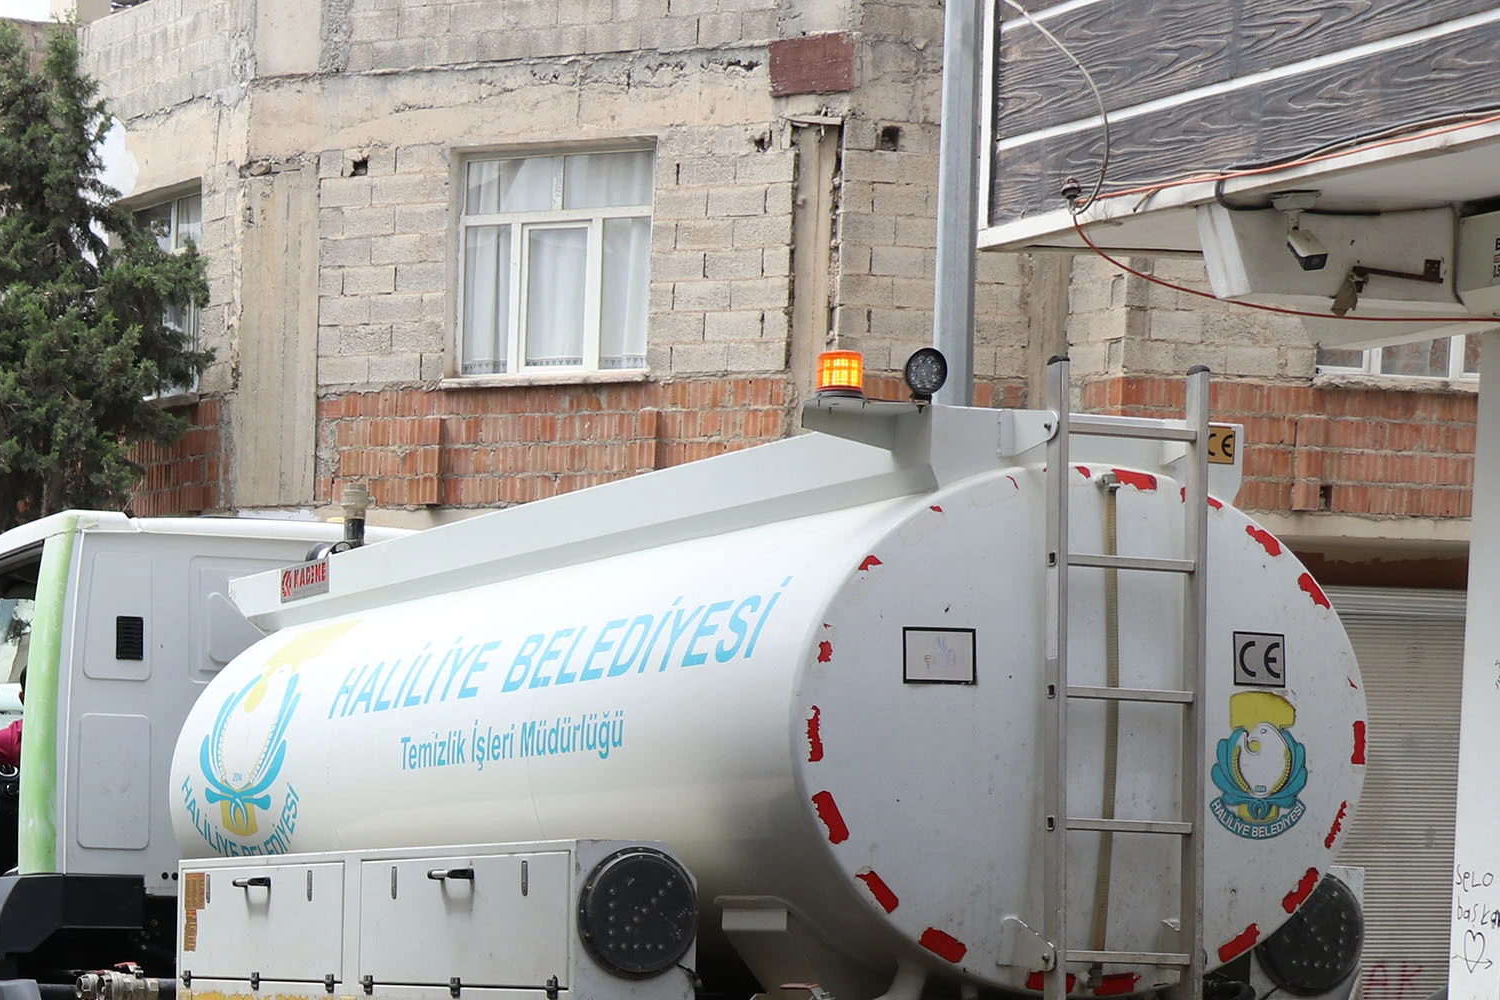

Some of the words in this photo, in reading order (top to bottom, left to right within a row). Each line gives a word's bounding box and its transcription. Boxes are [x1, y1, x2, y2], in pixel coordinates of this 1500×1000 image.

[327, 636, 500, 719] HALİLİYE
[501, 577, 793, 693] BELEDİYESİ
[1239, 640, 1281, 679] CE
[400, 730, 467, 771] Temizlik
[470, 717, 515, 772] İşleri
[519, 705, 624, 764] Müdürlüğü
[182, 776, 239, 857] HALİLİYE
[1212, 800, 1250, 836] HALİLİYE
[1251, 802, 1305, 838] BELEDİYESİ
